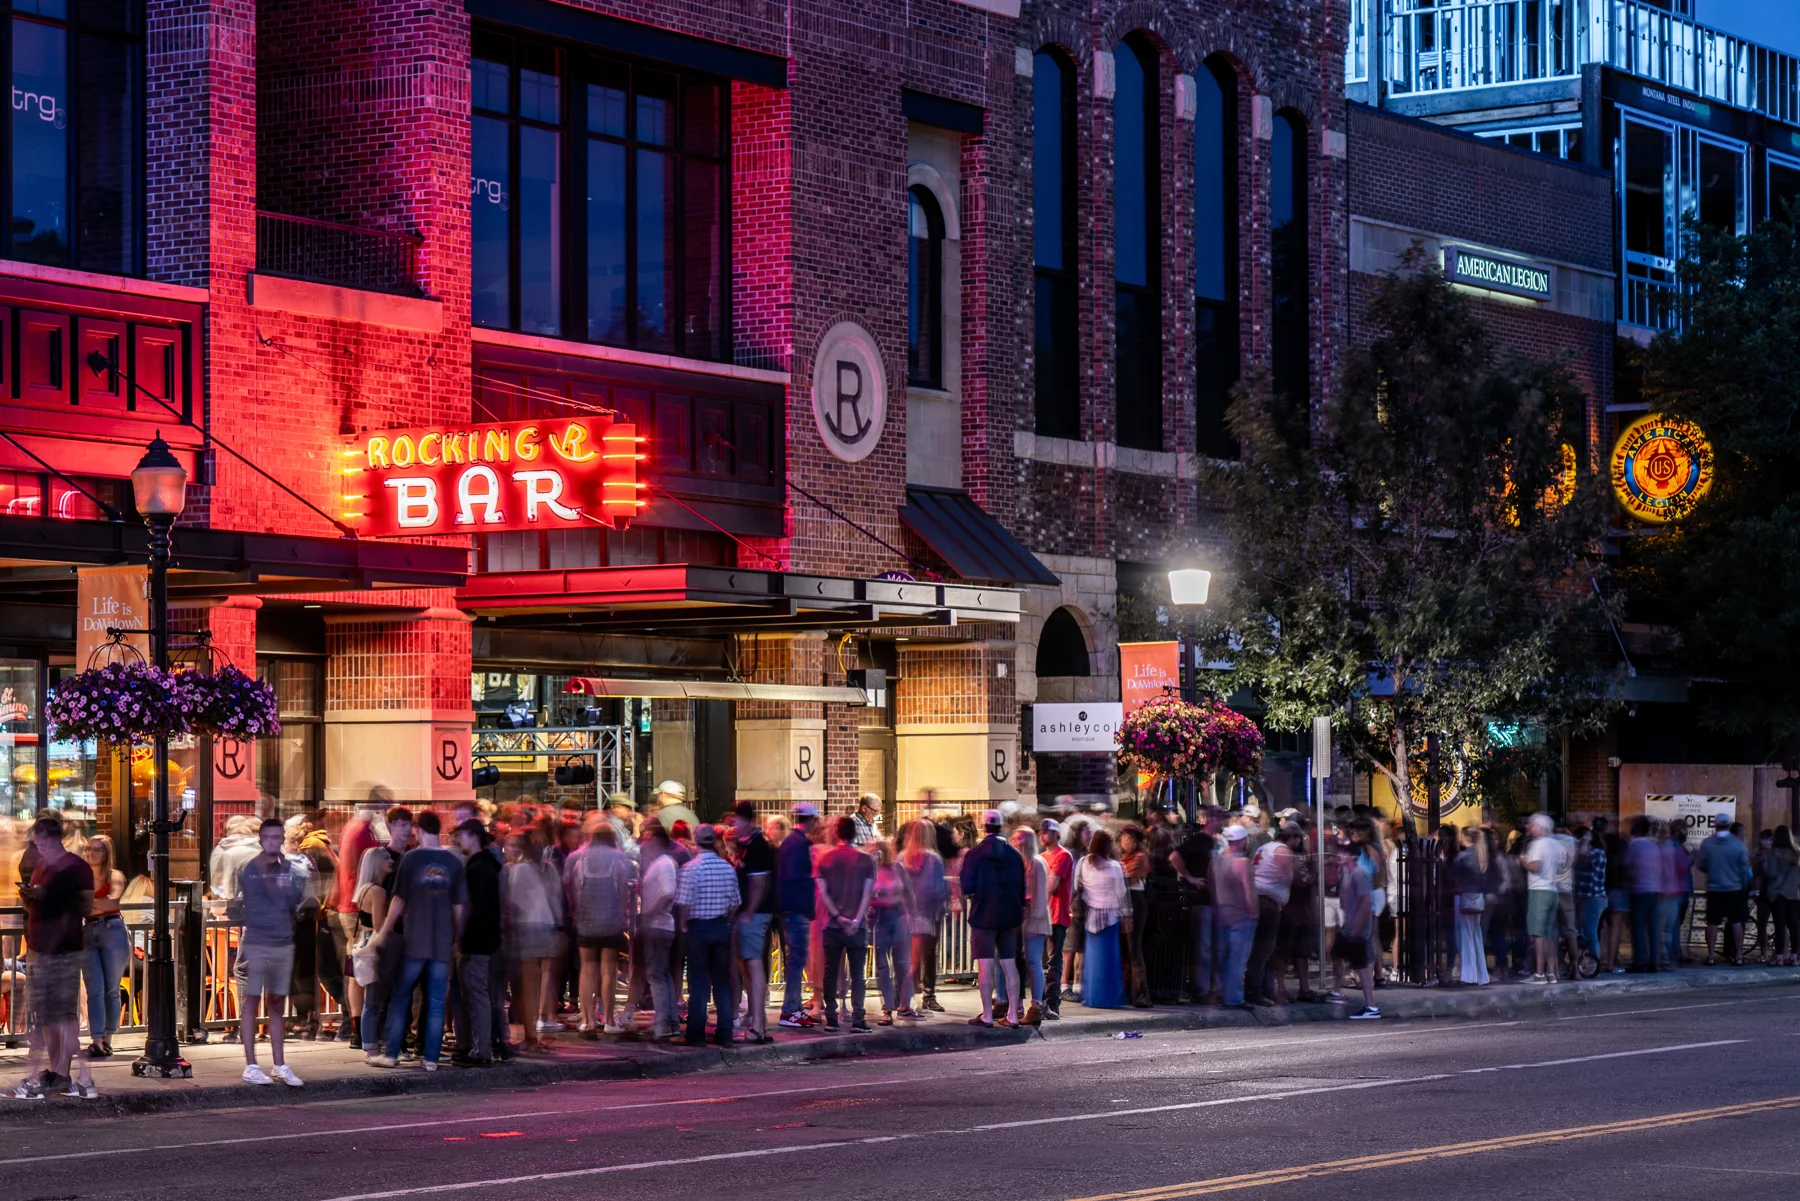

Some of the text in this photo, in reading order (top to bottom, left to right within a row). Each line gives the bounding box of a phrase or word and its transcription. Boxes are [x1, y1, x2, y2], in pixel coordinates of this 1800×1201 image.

[12, 85, 55, 121] trg
[1642, 86, 1665, 102] MONTANA
[1667, 93, 1681, 107] STEEL
[1457, 255, 1548, 292] AMERICAN LEGION
[367, 426, 542, 469] ROCKING
[384, 464, 583, 528] BAR
[93, 597, 132, 615] Life is
[1134, 664, 1167, 678] Life is
[0, 698, 28, 715] mino
[1040, 722, 1118, 735] ashleycol
[1684, 814, 1716, 829] OPE
